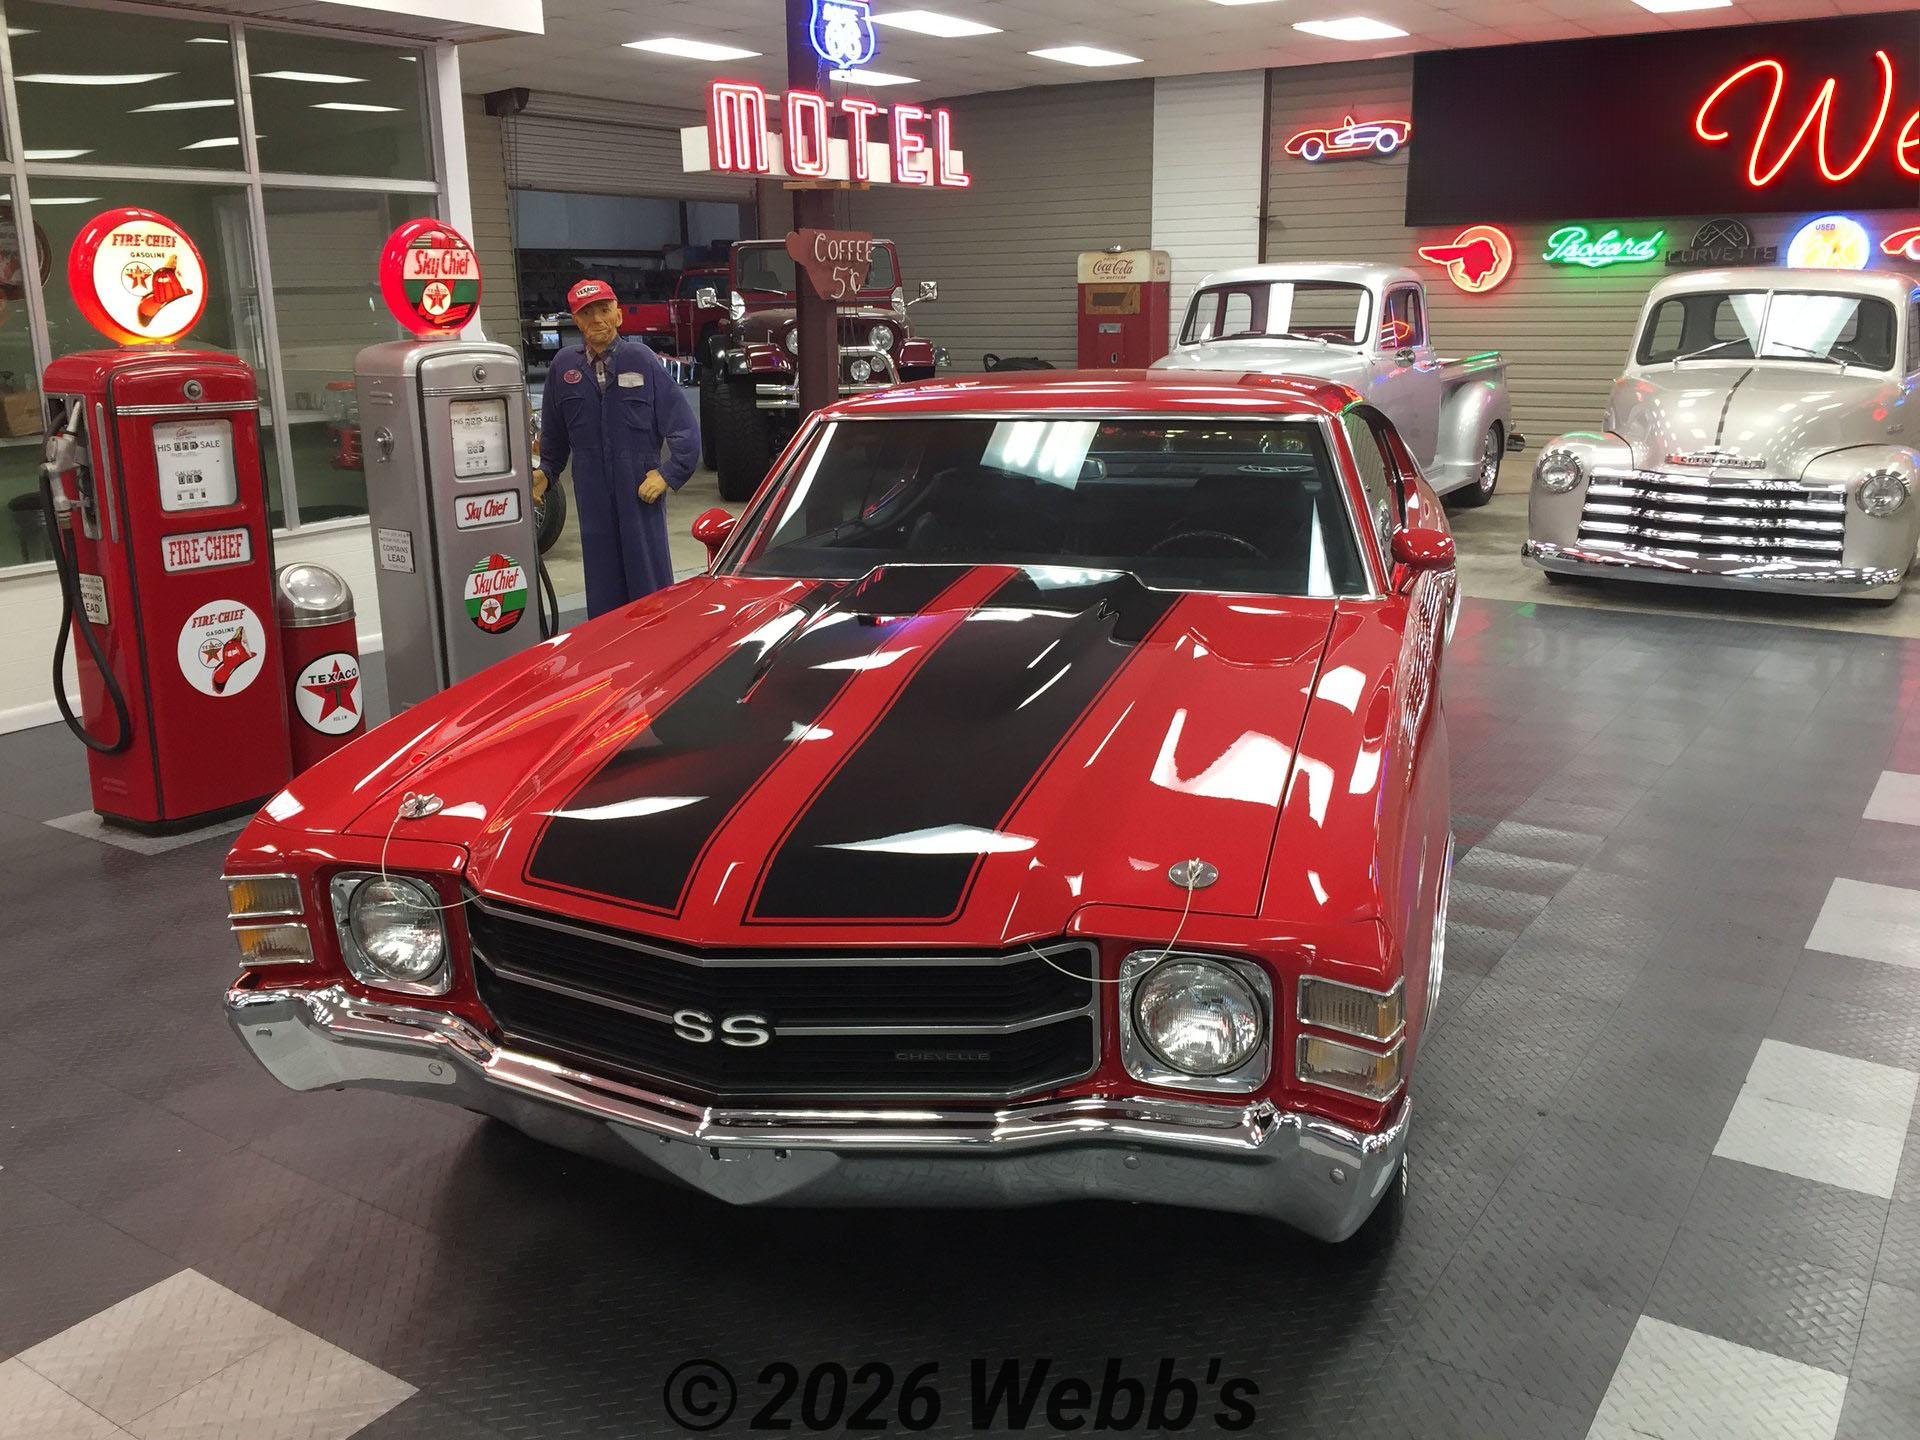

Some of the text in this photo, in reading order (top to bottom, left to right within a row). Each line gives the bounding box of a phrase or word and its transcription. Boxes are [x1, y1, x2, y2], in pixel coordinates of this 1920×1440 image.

[706, 80, 971, 188] MOTEL
[1815, 223, 1836, 231] USED
[112, 233, 178, 248] FIRE-CHIEF
[814, 232, 873, 262] COFFEE
[1543, 226, 1665, 267] Packard
[130, 251, 166, 259] GASOLINE
[414, 249, 471, 279] Sky Chief
[1092, 259, 1135, 276] Coca-Cola
[576, 286, 599, 297] TEXACO
[484, 415, 499, 423] SALE
[200, 439, 221, 448] SALE
[465, 497, 509, 521] Sky Chief
[168, 533, 243, 567] FIRE-CHIEF
[387, 553, 406, 563] LEAD
[472, 567, 519, 595] Sky Chief
[84, 602, 100, 613] EAD
[192, 608, 245, 629] FIRE-CHIEF
[206, 626, 235, 637] GASOLINE
[308, 667, 357, 684] TEXACO
[672, 1009, 771, 1048] SS
[894, 1051, 990, 1062] CHEVELLE
